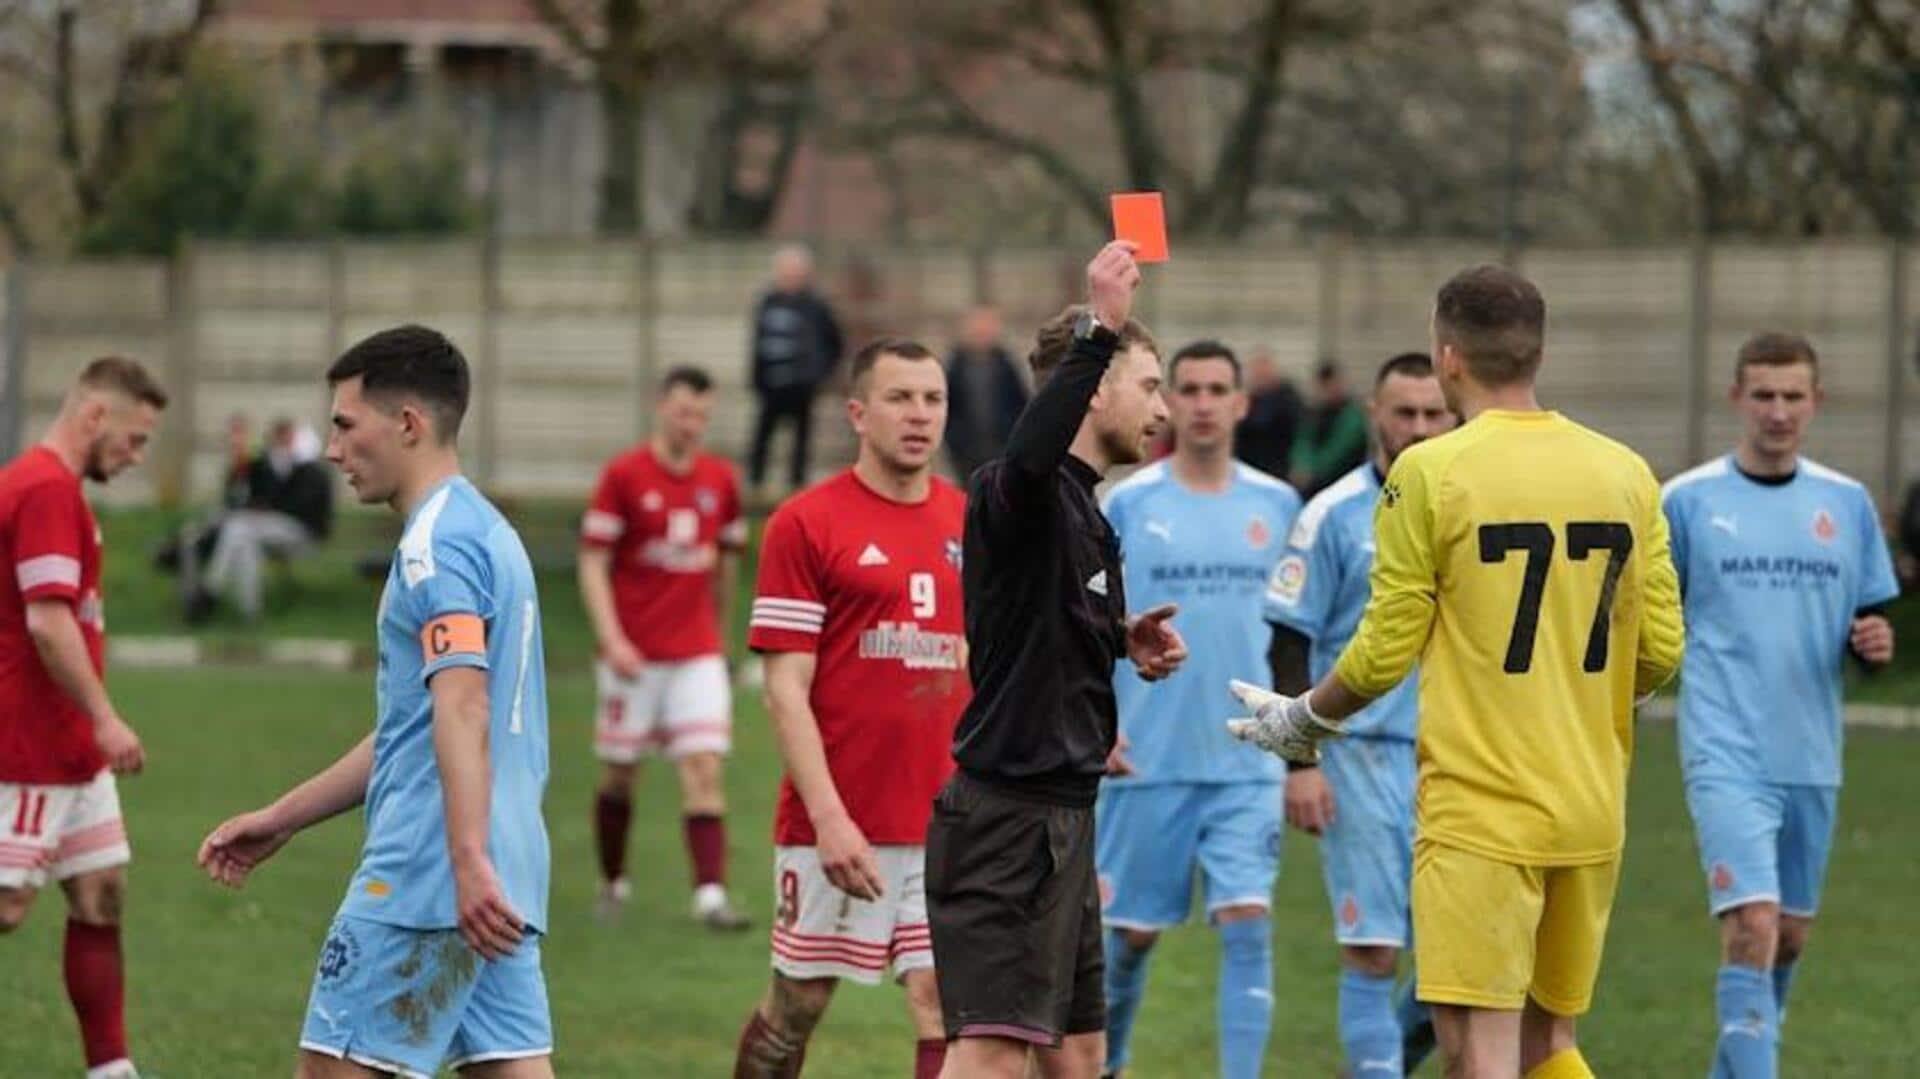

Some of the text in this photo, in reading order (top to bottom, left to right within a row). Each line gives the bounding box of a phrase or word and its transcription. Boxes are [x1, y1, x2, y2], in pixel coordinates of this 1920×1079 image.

[1720, 556, 1839, 579] MARATHON
[909, 572, 937, 619] 9
[1478, 522, 1634, 675] 77
[431, 623, 451, 655] C
[13, 787, 46, 836] 11
